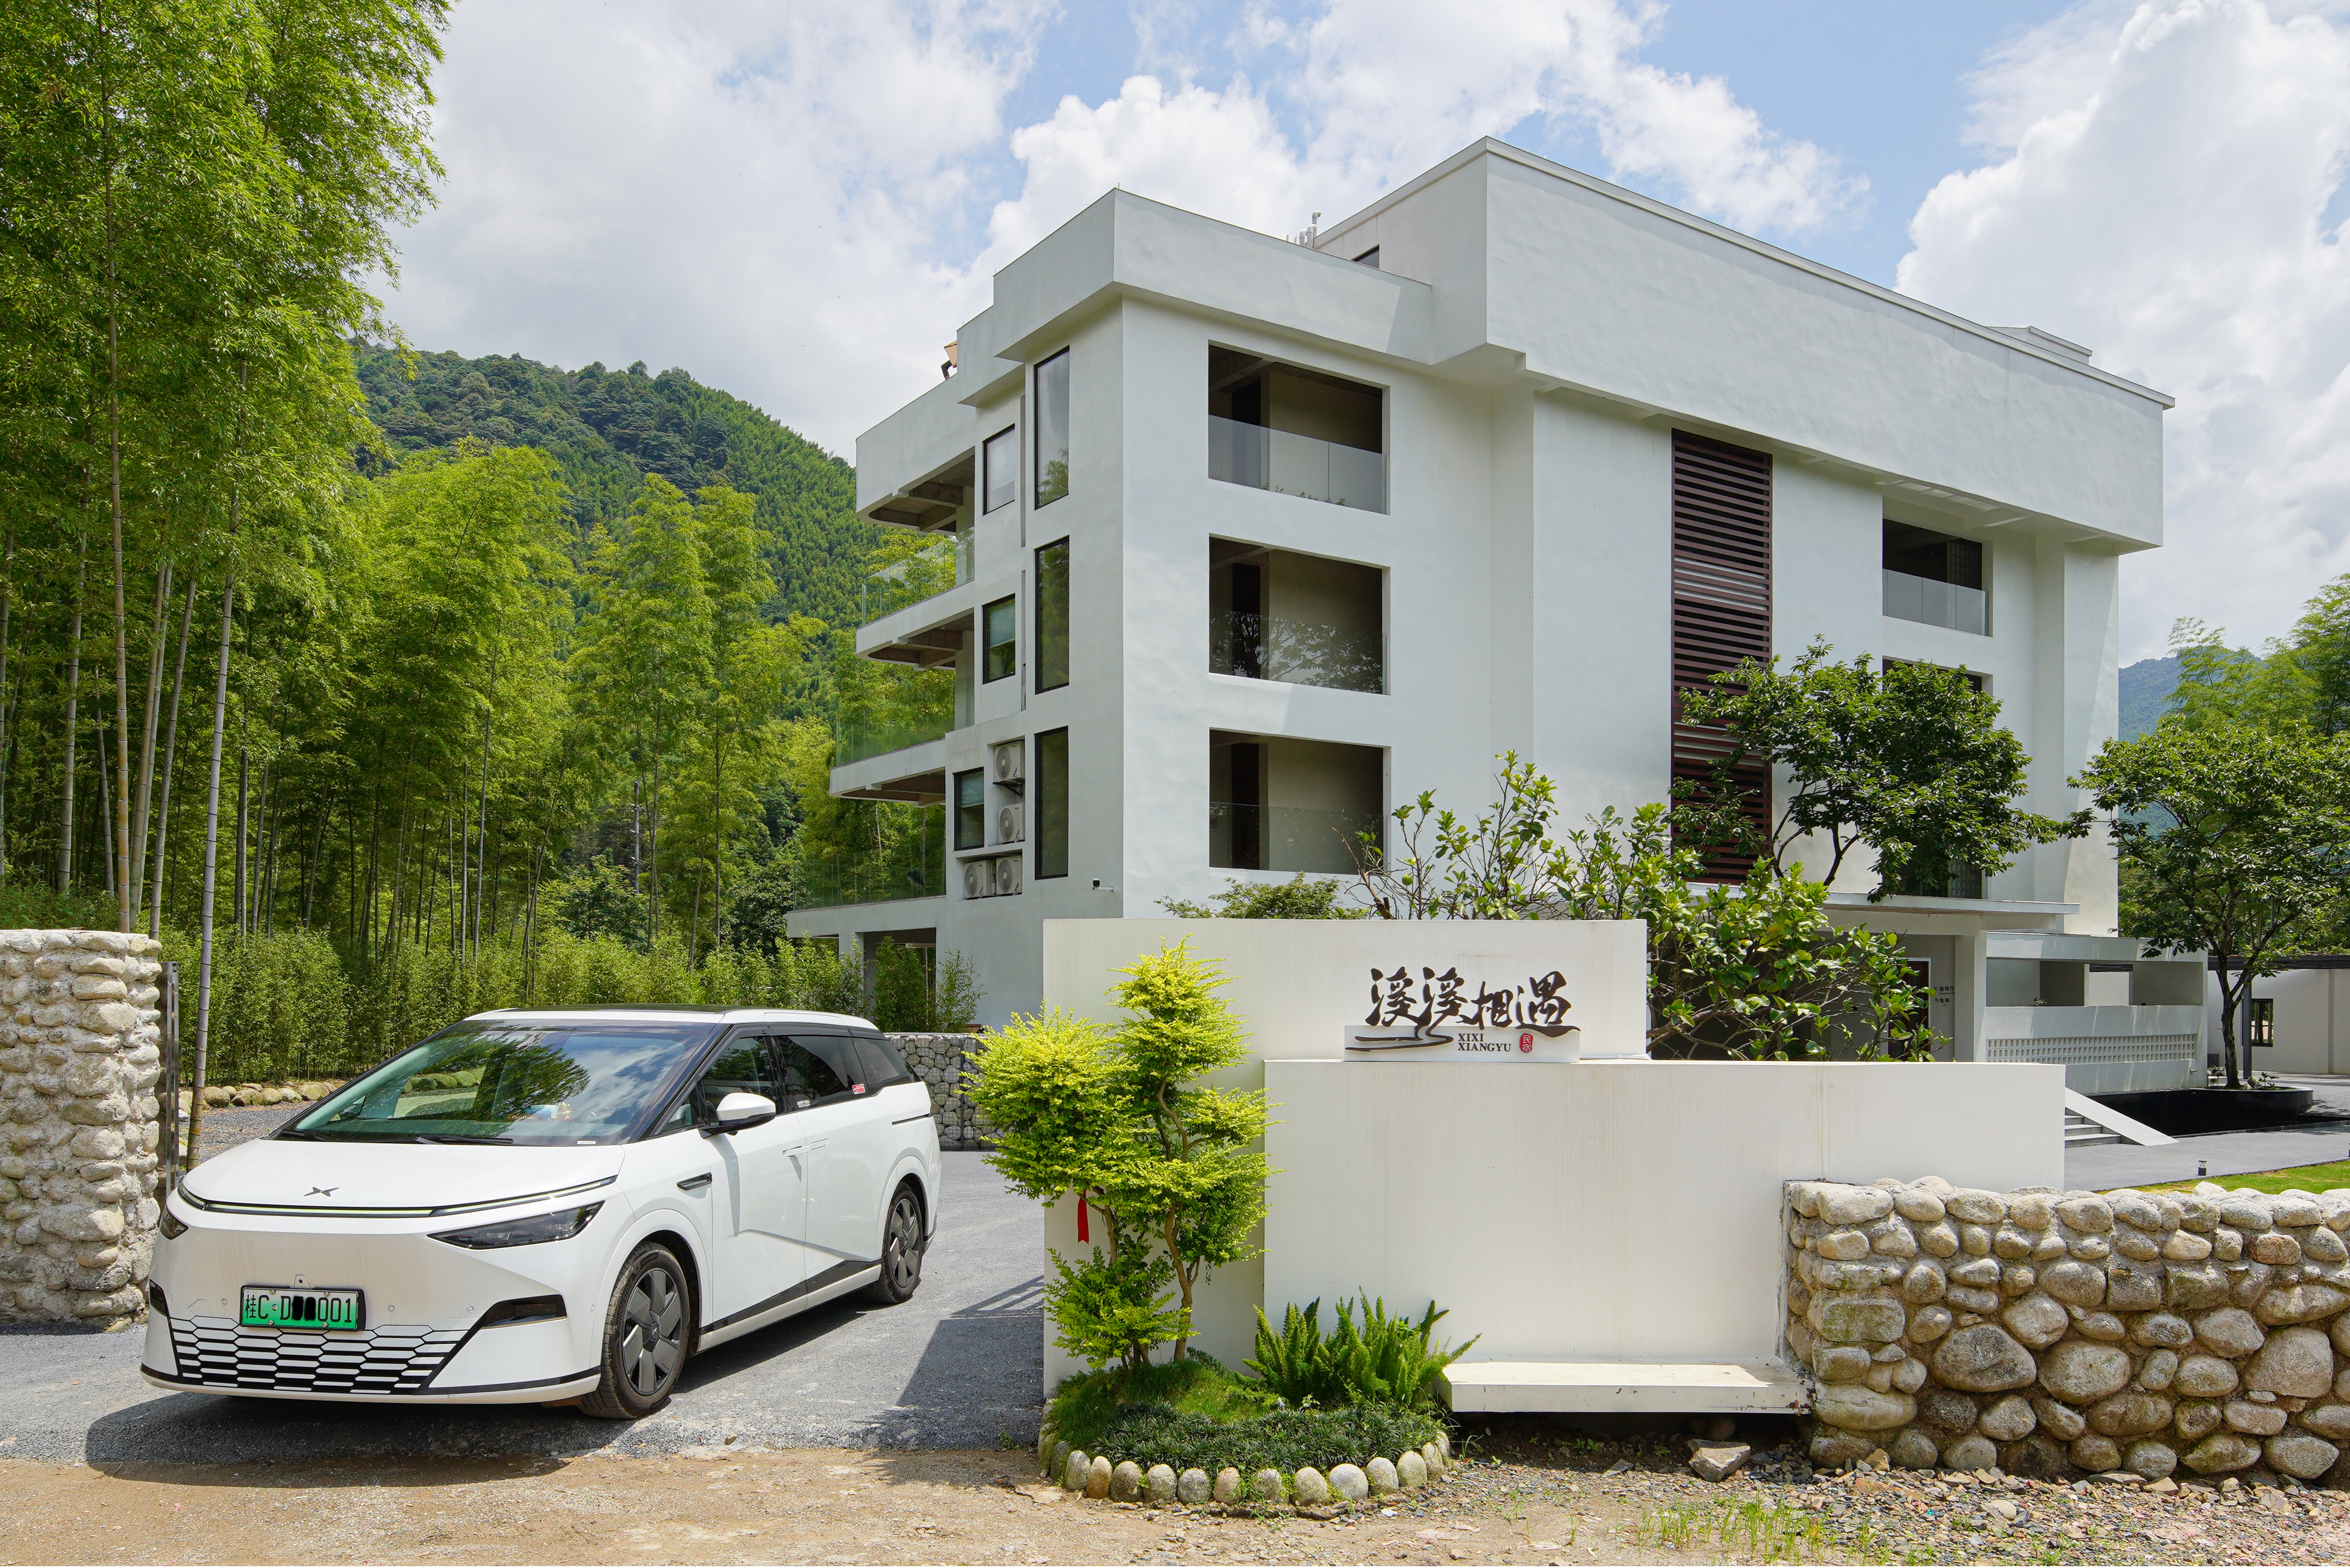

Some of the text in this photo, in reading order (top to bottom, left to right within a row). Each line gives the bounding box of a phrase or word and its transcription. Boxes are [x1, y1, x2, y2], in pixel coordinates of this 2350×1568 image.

[1346, 966, 1581, 1052] 溪溪相遇
[1458, 1033, 1484, 1042] XIXI
[1522, 1035, 1532, 1053] 民宿
[1458, 1042, 1511, 1052] XIANGYU
[280, 1295, 352, 1323] D001
